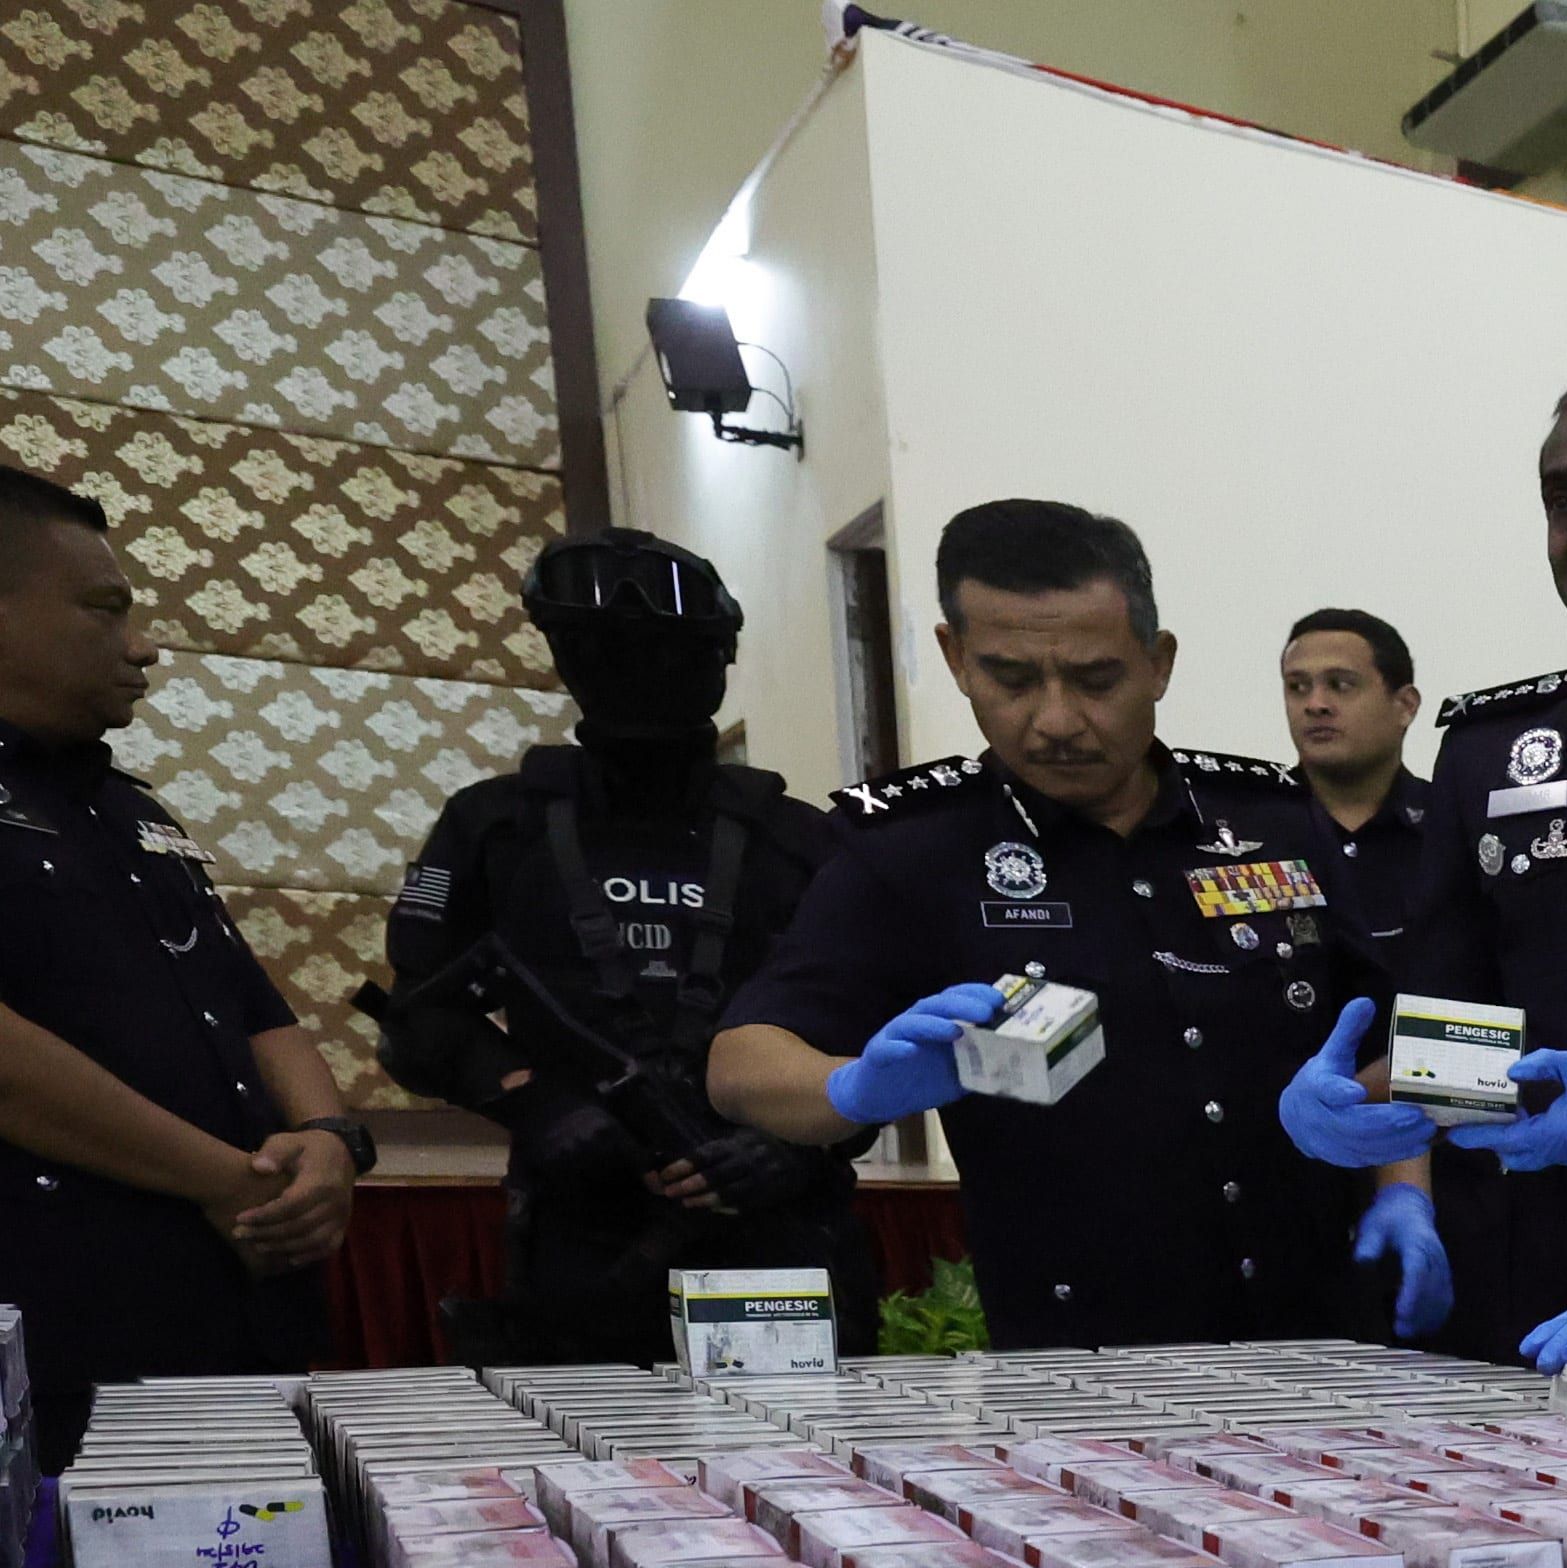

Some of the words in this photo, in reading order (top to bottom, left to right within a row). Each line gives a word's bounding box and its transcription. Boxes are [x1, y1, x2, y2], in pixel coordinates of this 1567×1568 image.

[603, 877, 705, 908] OLIS
[1005, 908, 1051, 920] AFANDI
[1445, 1023, 1511, 1041] PENGESIC
[744, 1300, 818, 1313] PENGESIC
[790, 1357, 824, 1369] hovid
[92, 1505, 154, 1523] hovid
